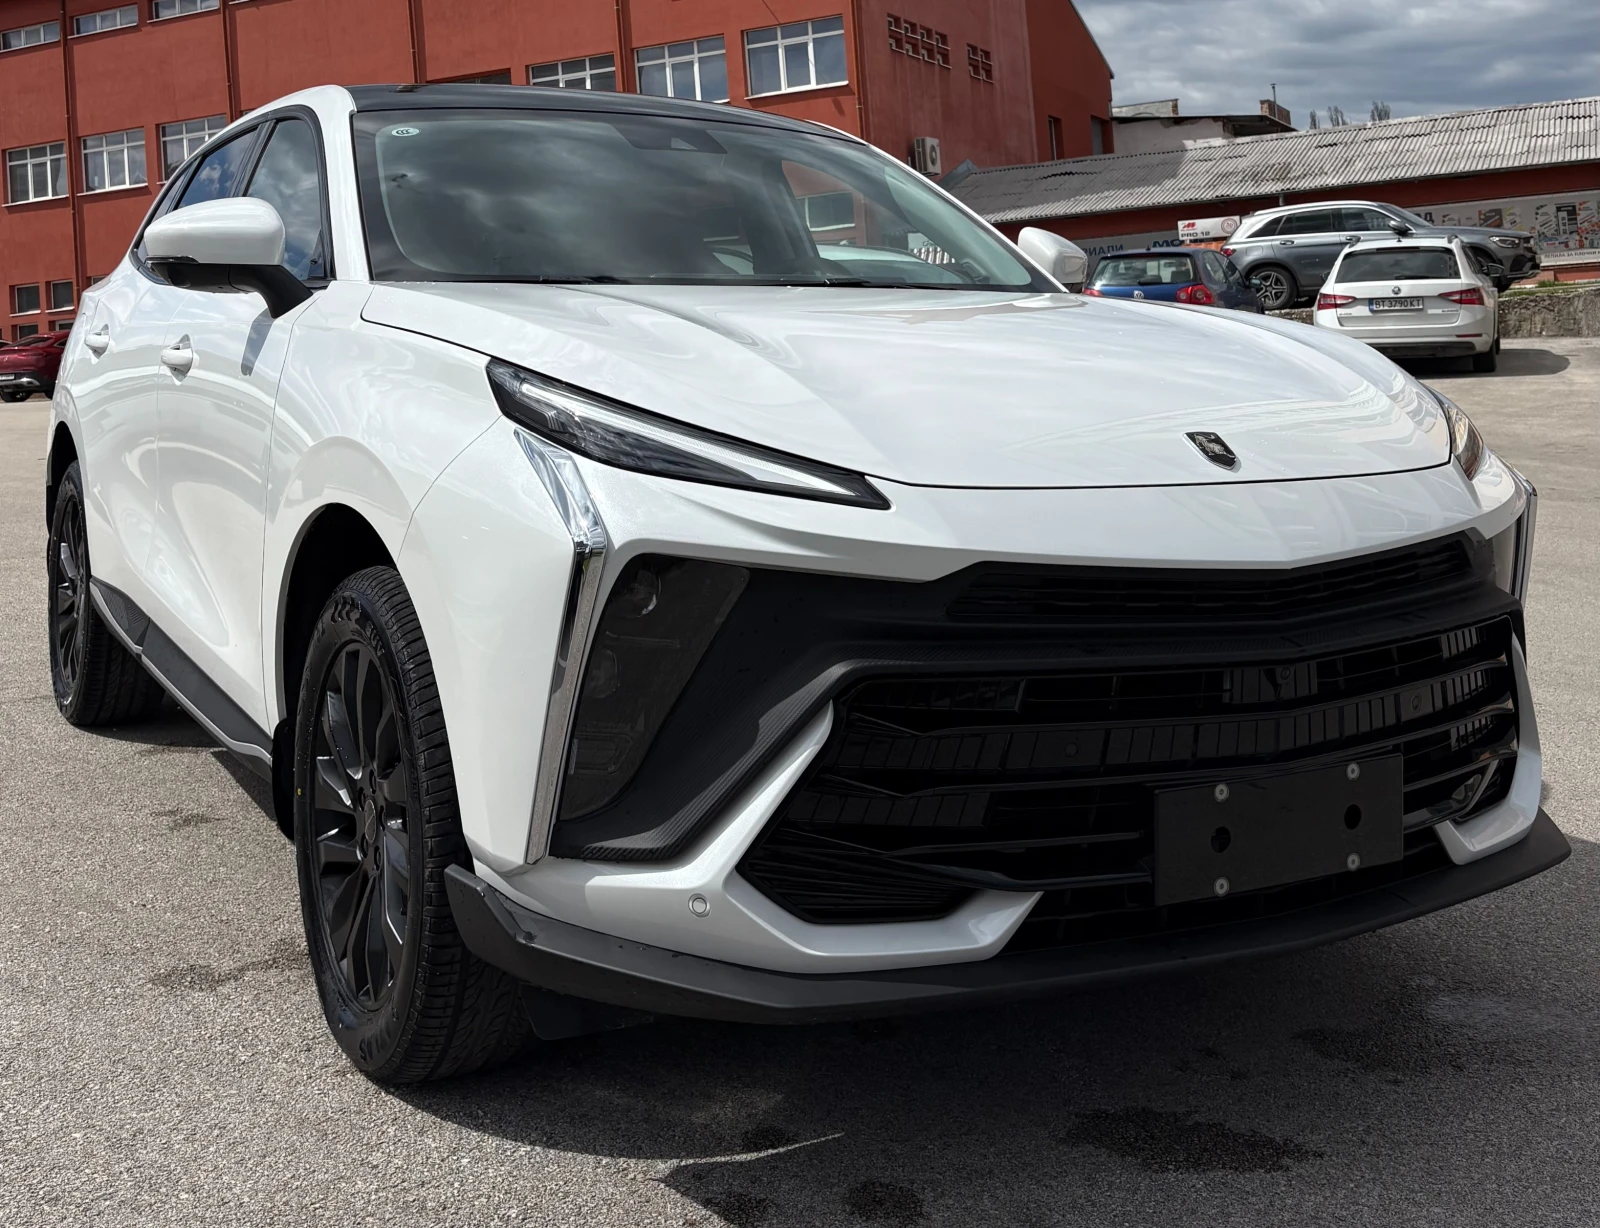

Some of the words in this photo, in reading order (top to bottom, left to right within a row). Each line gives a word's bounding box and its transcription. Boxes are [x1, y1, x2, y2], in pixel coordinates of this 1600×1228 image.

[1374, 300, 1386, 308] BT
[1387, 299, 1409, 308] 3790
[1409, 298, 1421, 307] KT
